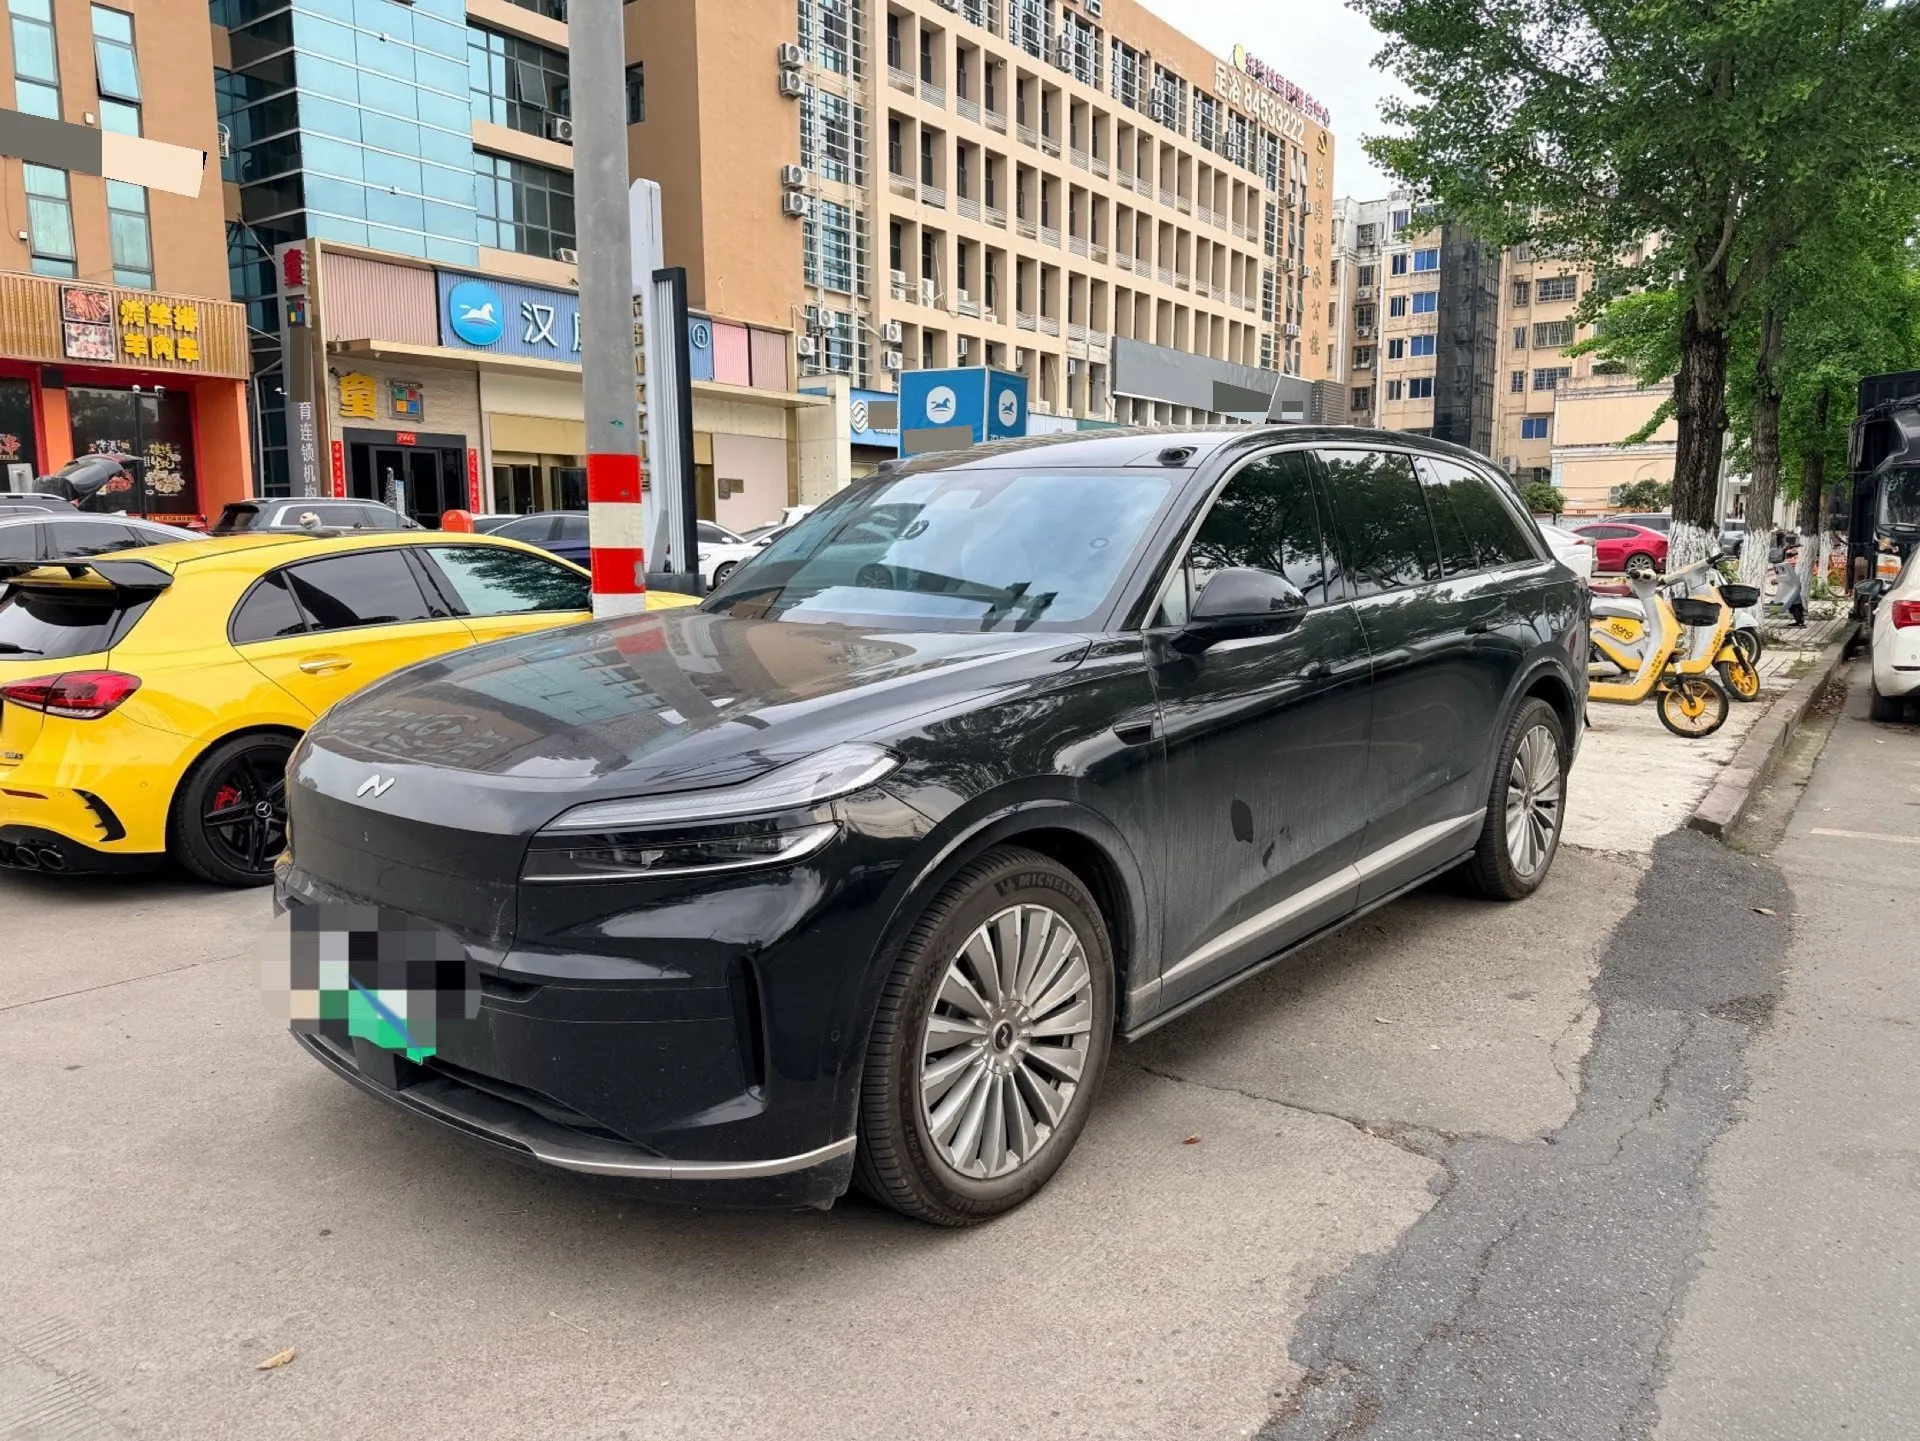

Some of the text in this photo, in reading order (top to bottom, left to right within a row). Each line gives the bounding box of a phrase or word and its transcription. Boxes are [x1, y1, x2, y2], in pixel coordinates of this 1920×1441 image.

[1243, 83, 1305, 148] 84533222
[120, 299, 198, 333] 烤羊排
[123, 332, 200, 363] 羊肉串
[1018, 873, 1081, 902] MICHELIN
